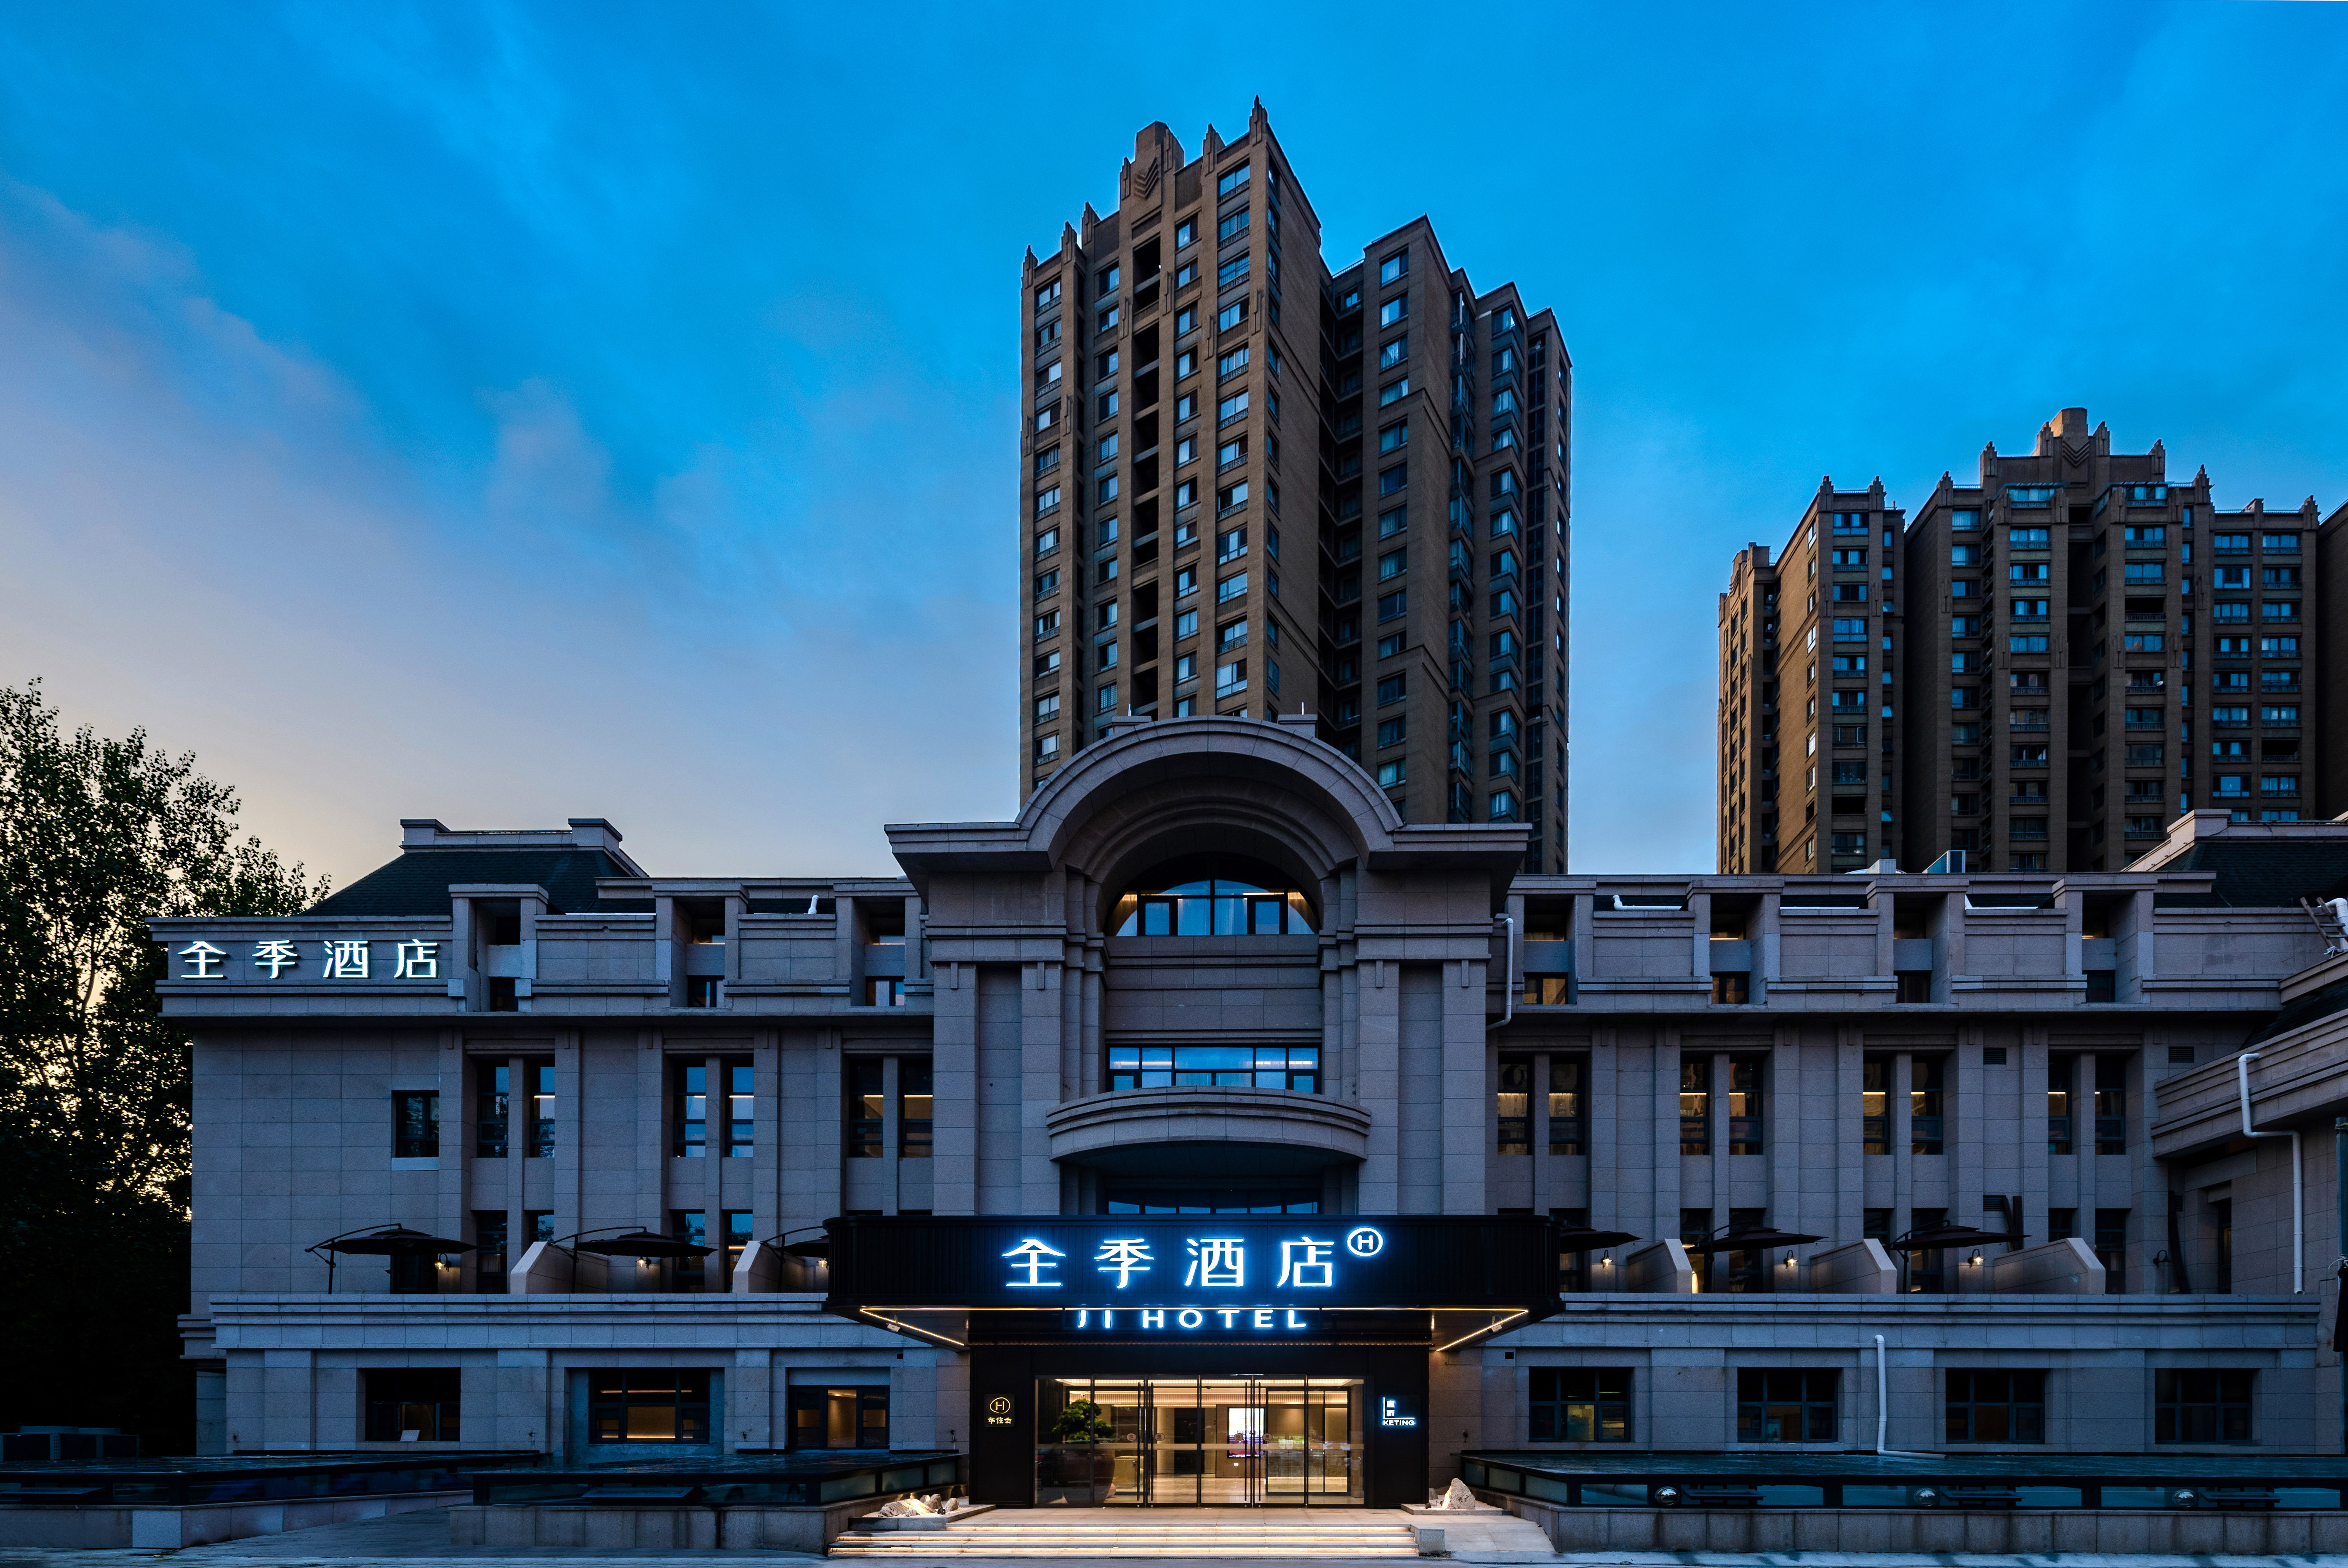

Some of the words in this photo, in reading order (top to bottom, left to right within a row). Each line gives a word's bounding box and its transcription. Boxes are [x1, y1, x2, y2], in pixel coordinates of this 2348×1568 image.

[177, 939, 438, 979] 全季酒店
[1002, 1236, 1334, 1289] 全季酒店
[1077, 1310, 1111, 1328] JI
[1143, 1310, 1306, 1328] HOTEL
